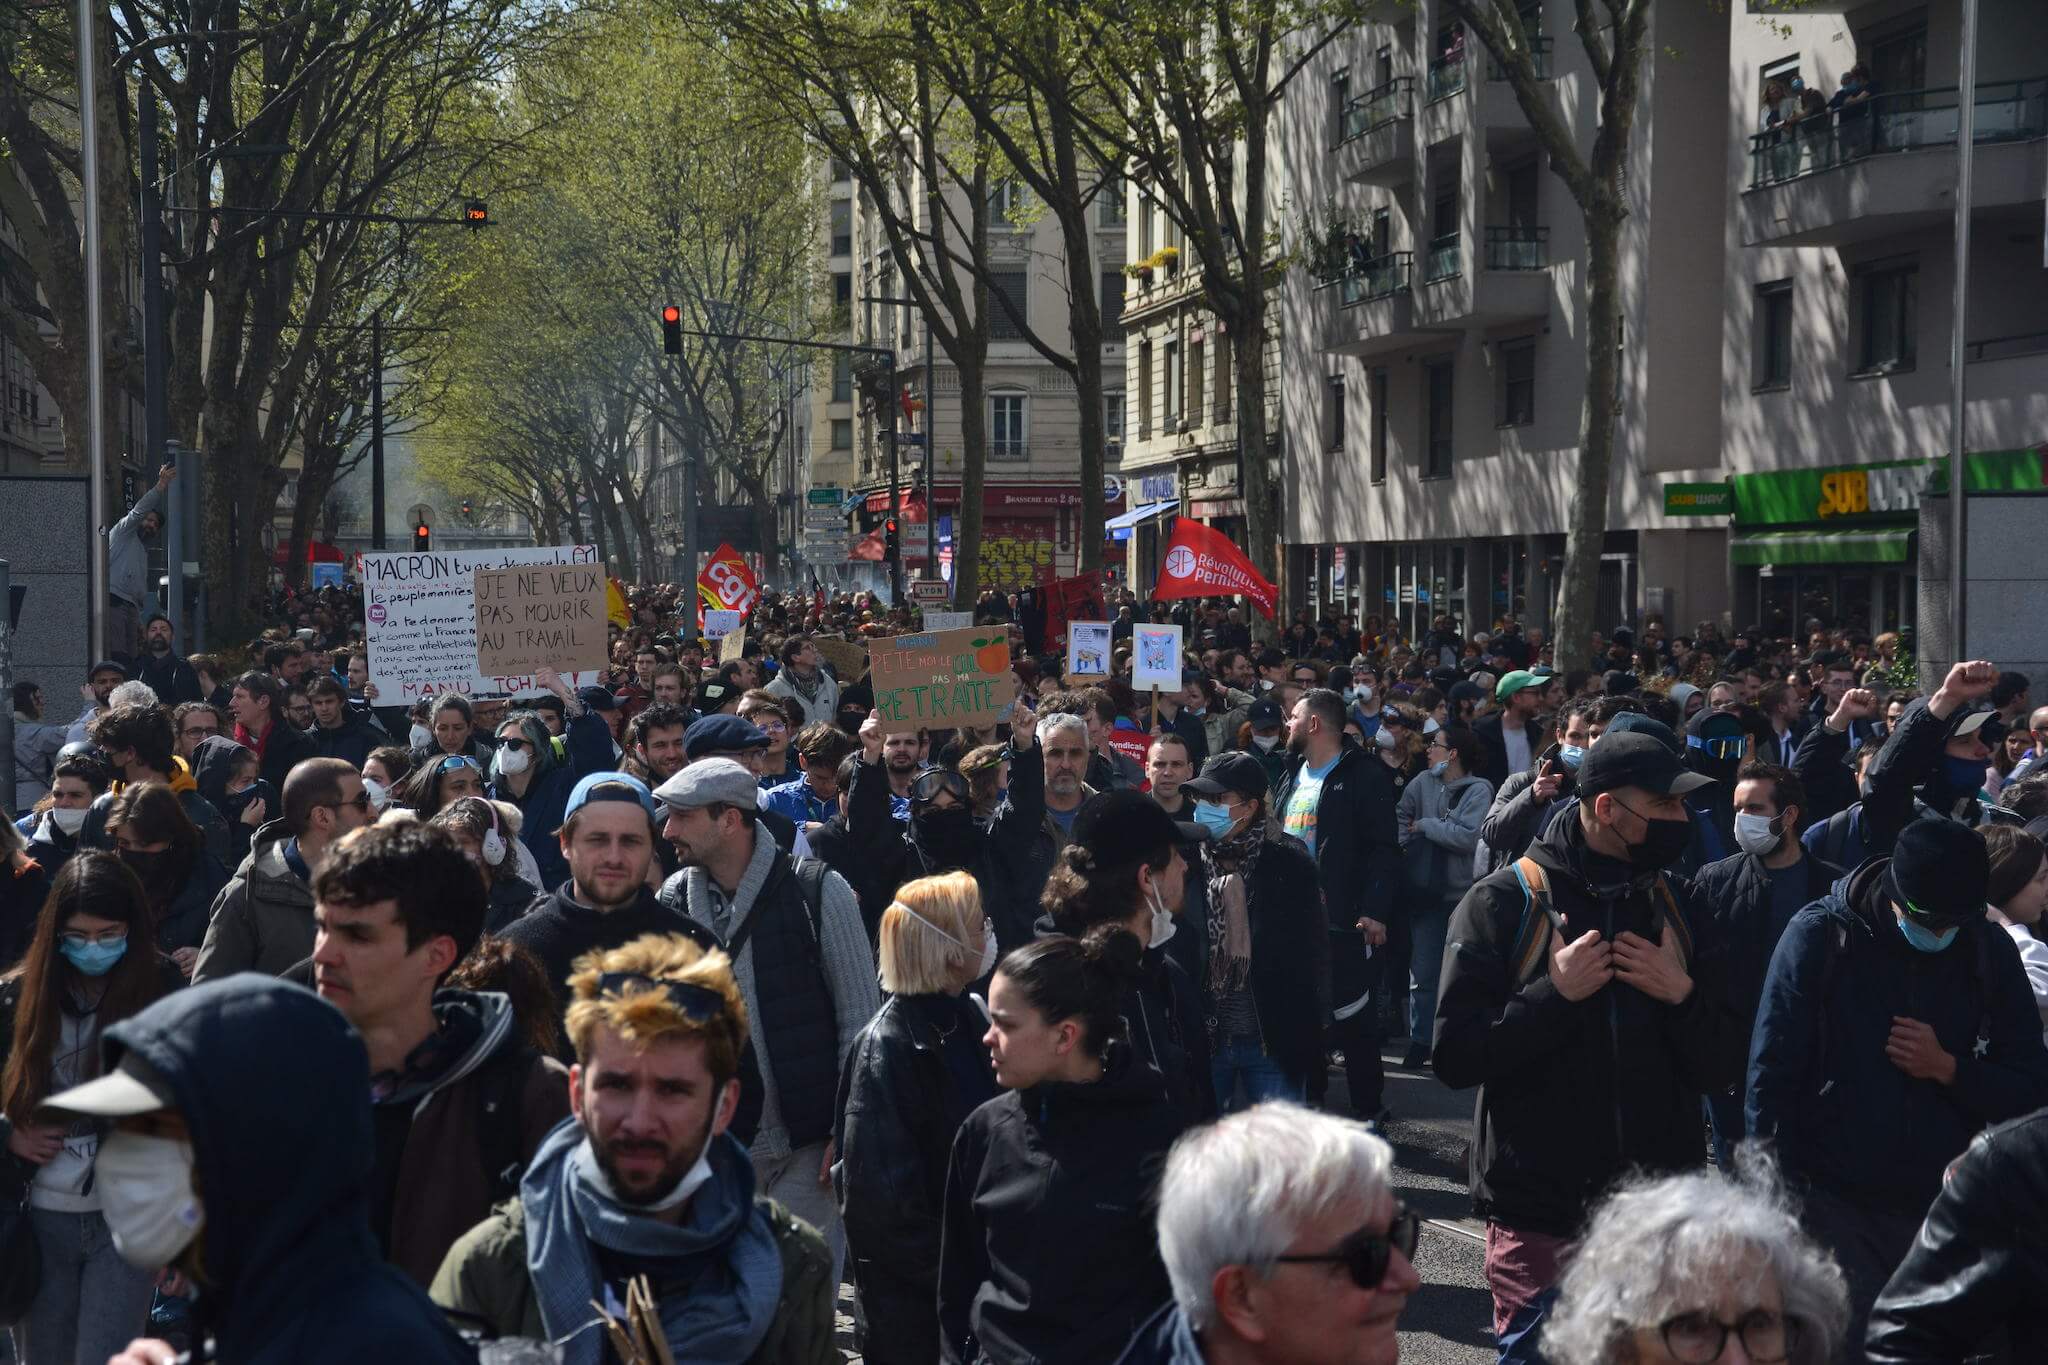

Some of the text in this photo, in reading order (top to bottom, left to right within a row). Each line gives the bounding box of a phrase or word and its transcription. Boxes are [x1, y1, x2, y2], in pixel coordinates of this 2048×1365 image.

[1669, 493, 1727, 505] SUBWAY
[1818, 464, 1933, 518] SUBWAY
[365, 555, 448, 580] MACRON
[479, 570, 601, 600] JE NE VEUX
[708, 562, 758, 613] CGT
[919, 587, 943, 595] LYON
[480, 597, 594, 625] PAS MOURIR
[480, 625, 585, 651] AU TRAVAIL
[406, 652, 478, 663] embaucheron
[402, 681, 472, 699] MANU
[931, 673, 970, 684] PAS MA
[875, 679, 1001, 721] RETRAITE
